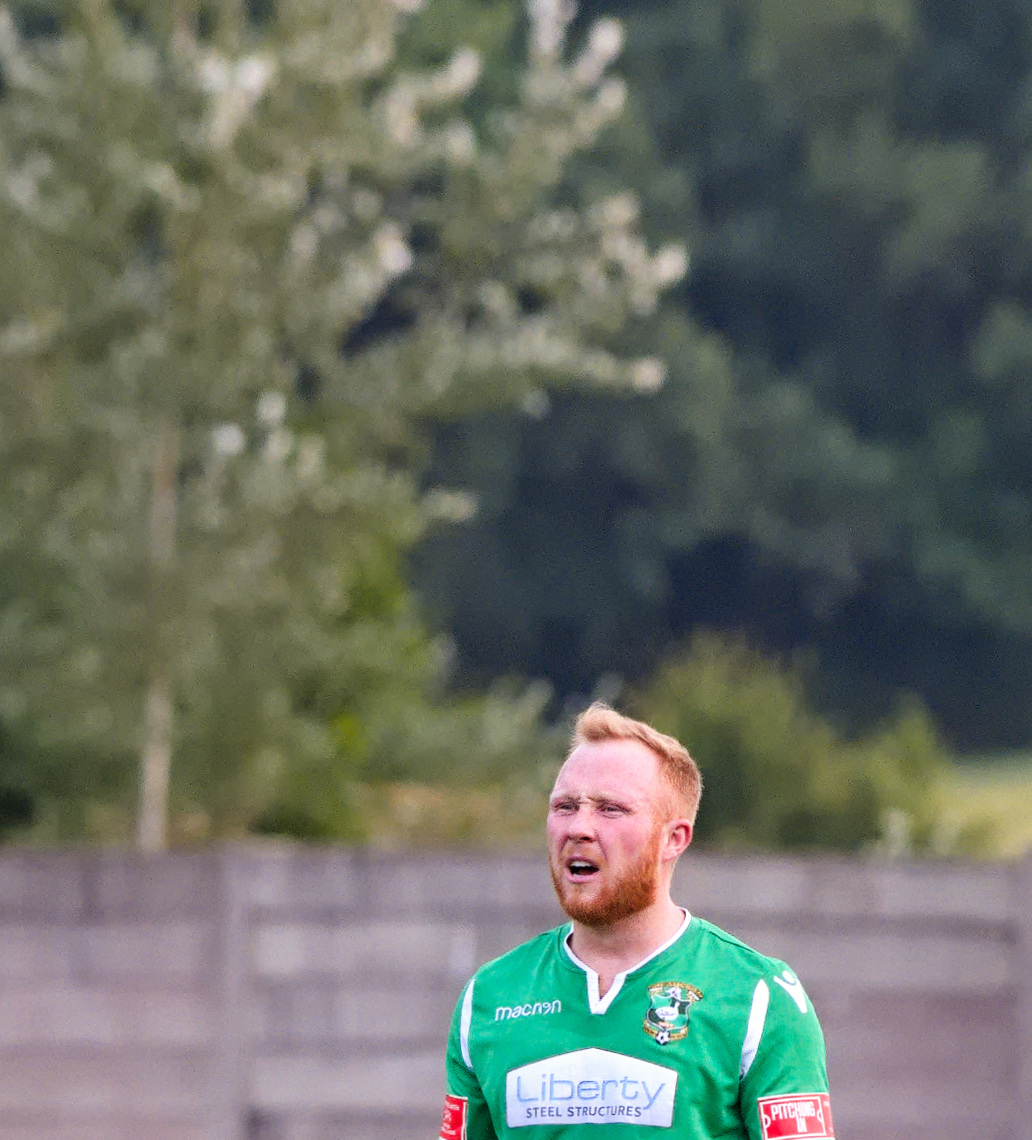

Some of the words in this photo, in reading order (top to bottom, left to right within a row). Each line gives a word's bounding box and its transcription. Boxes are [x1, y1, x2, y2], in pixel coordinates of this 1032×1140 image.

[494, 999, 562, 1021] macron
[517, 1073, 666, 1110] Liberty
[526, 1106, 563, 1119] STEEL
[567, 1105, 642, 1118] STRUCTURES
[770, 1101, 816, 1121] PITCHING
[796, 1117, 807, 1133] IN
